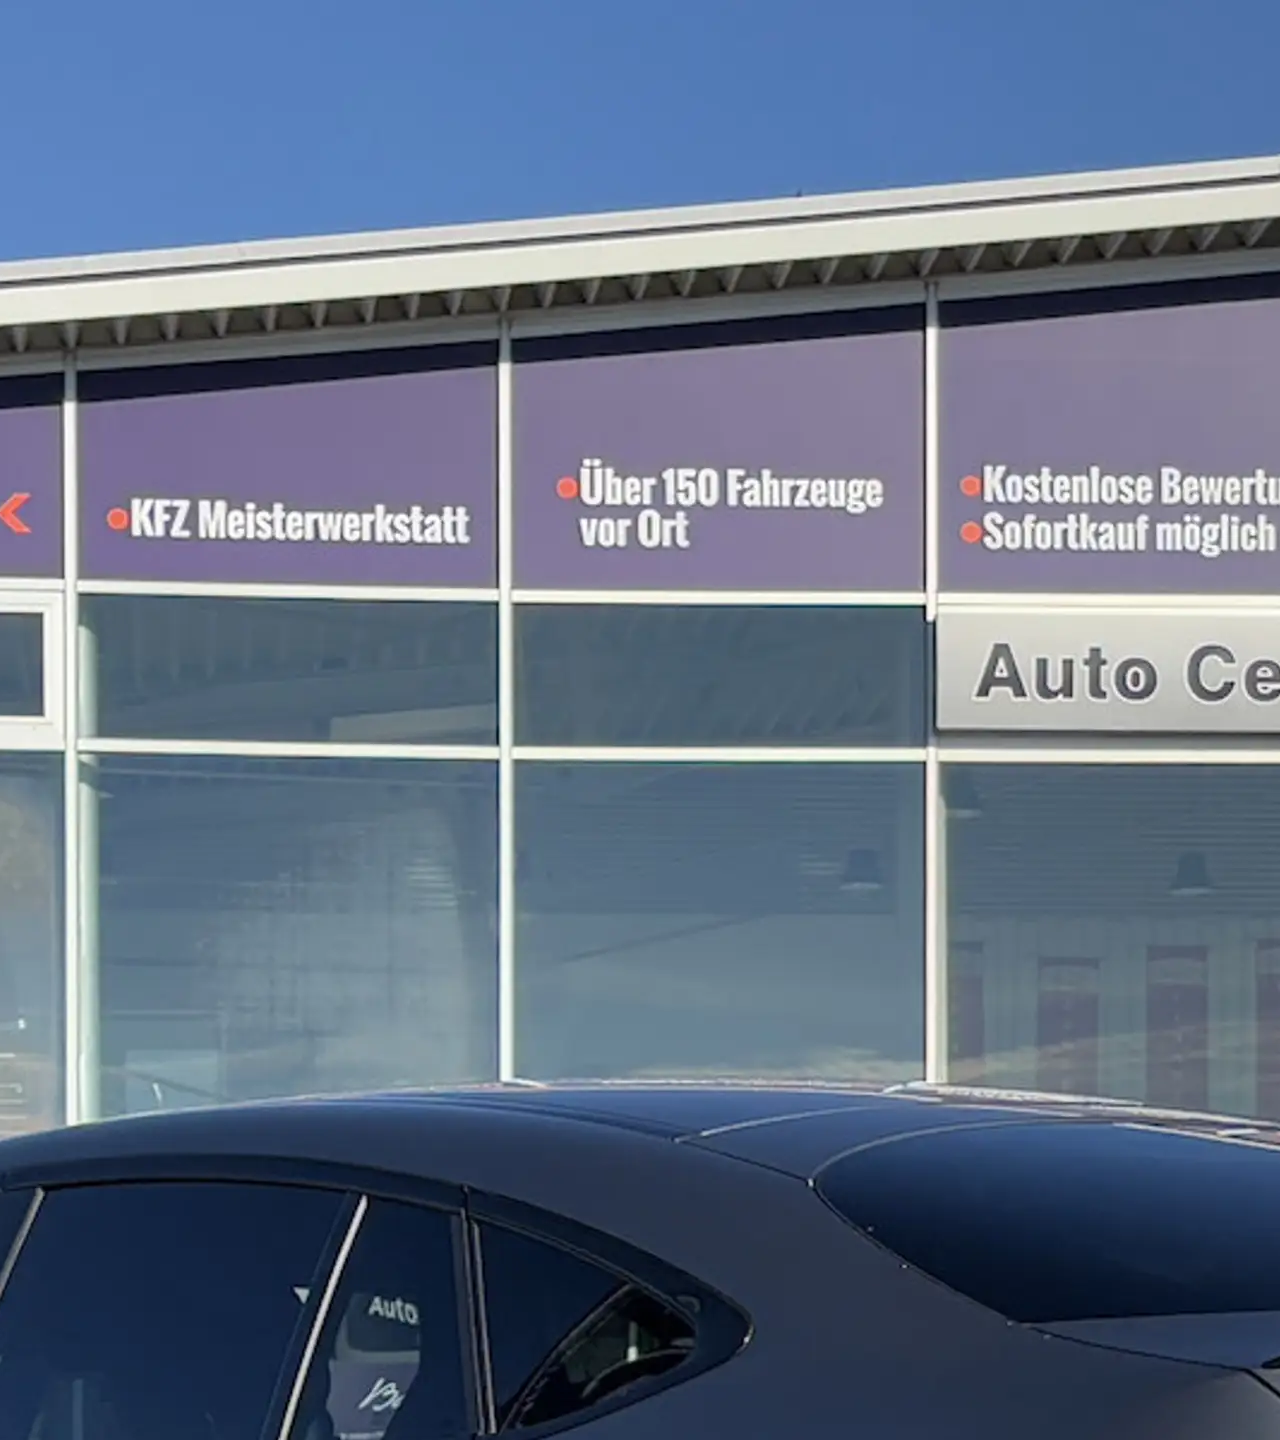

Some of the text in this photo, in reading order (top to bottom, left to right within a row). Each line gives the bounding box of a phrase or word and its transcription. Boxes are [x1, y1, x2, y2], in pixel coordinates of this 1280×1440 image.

[581, 459, 884, 514] Über 150 Fahrzeuge
[983, 466, 1154, 505] Kostenlose
[131, 498, 471, 544] KFZ Meisterwerkstatt
[579, 509, 690, 548] vor Ort
[983, 512, 1277, 557] Sofortkauf möglich
[975, 643, 1158, 702] Auto
[369, 1296, 419, 1325] Auto
